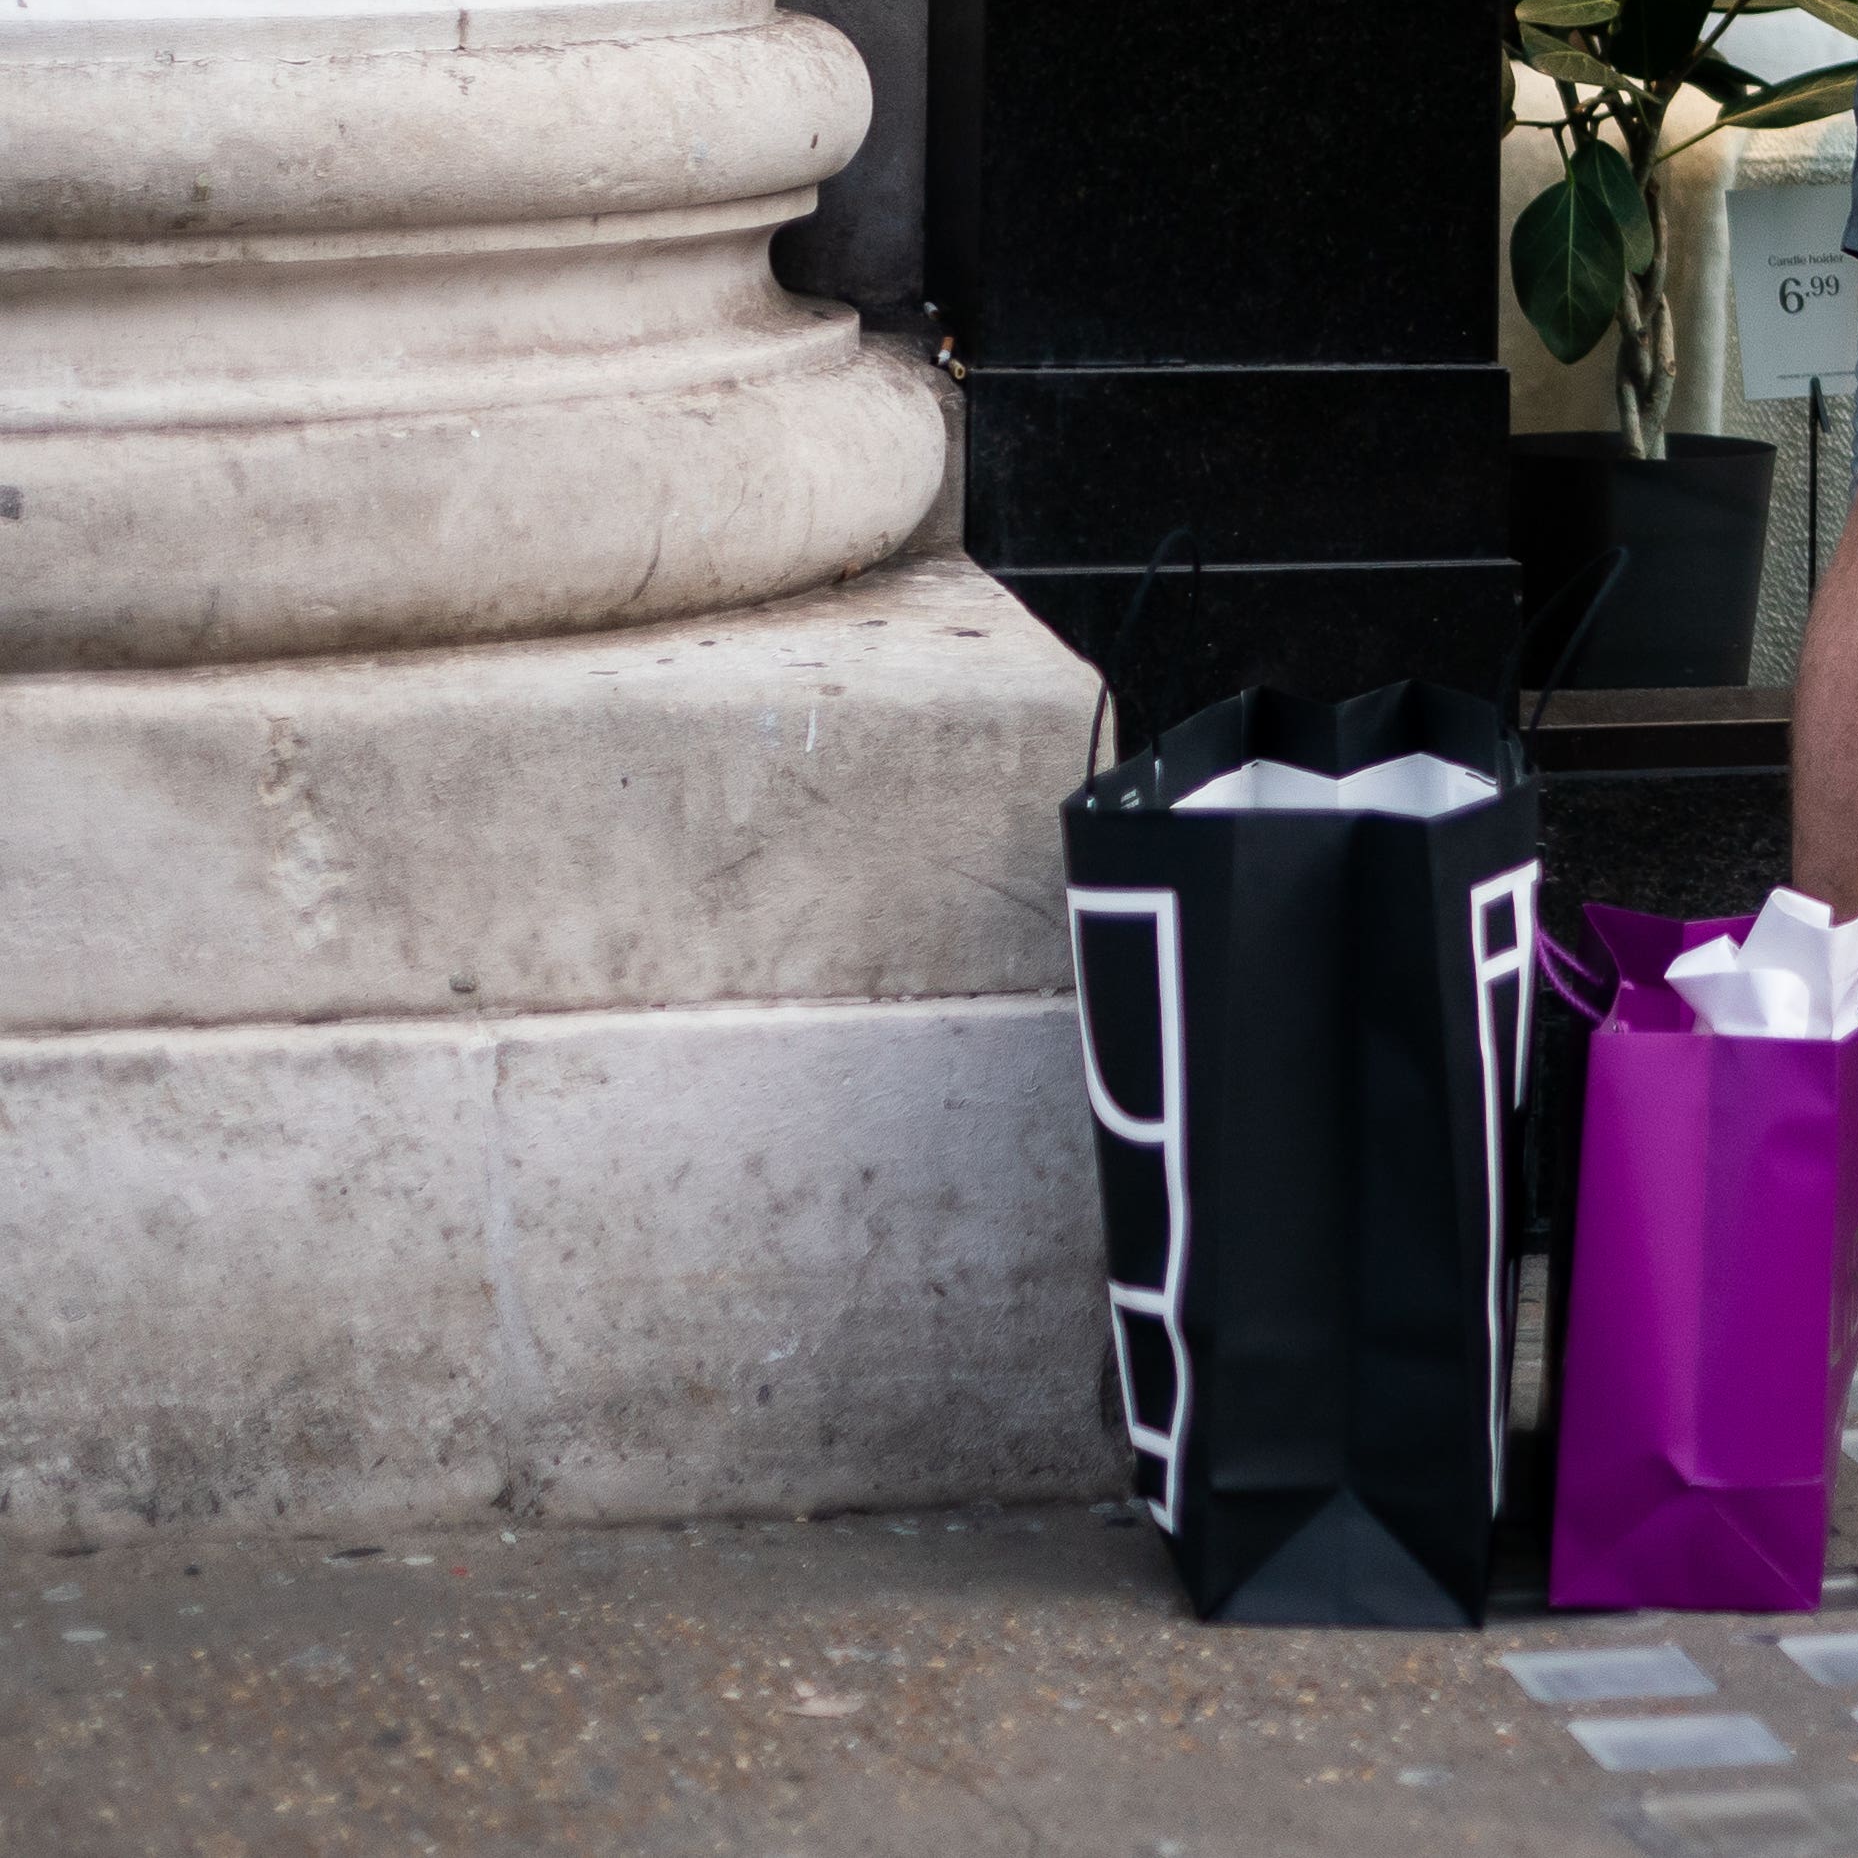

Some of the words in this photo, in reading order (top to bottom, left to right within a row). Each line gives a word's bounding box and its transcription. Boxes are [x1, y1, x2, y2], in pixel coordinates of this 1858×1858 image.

[1768, 253, 1806, 267] Candle
[1808, 252, 1844, 264] holder
[1779, 274, 1840, 315] 6.99
